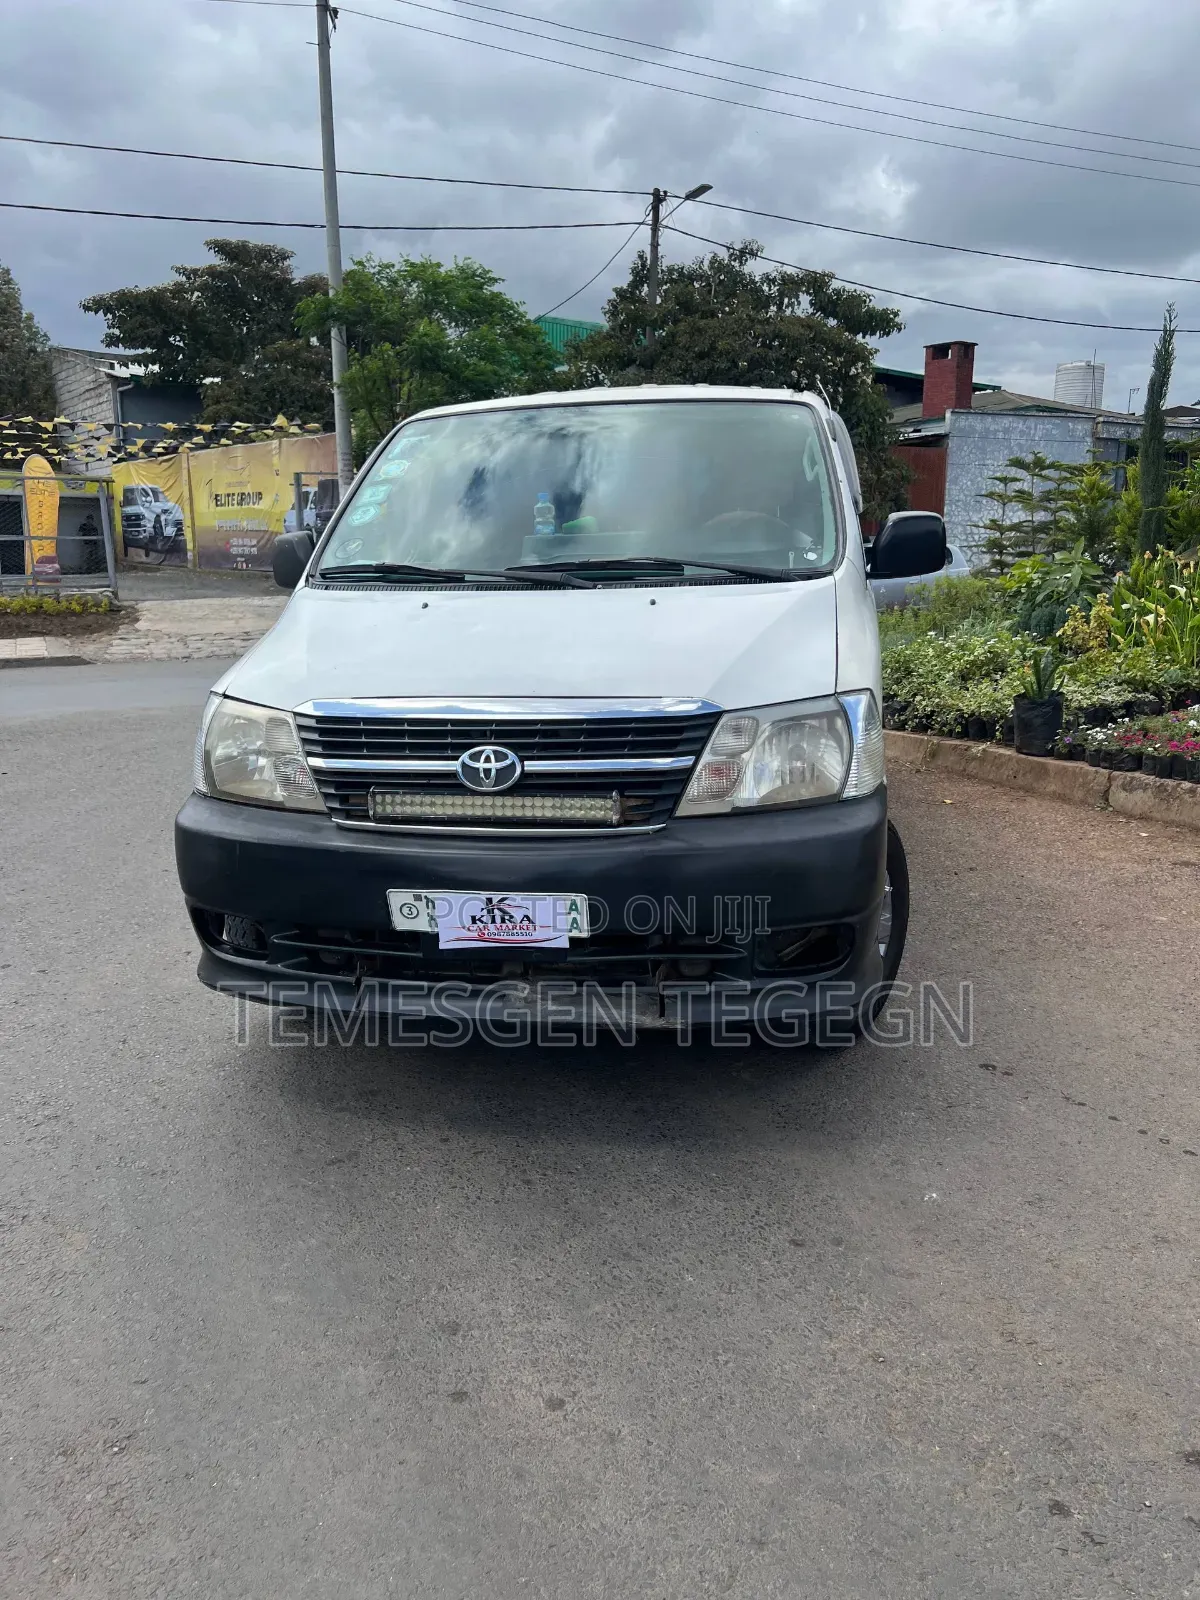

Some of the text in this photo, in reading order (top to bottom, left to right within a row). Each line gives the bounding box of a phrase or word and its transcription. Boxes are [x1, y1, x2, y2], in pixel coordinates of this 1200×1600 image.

[214, 491, 263, 507] ELITE GROUP
[469, 914, 536, 925] KIRA
[467, 923, 537, 932] CAR MARKET
